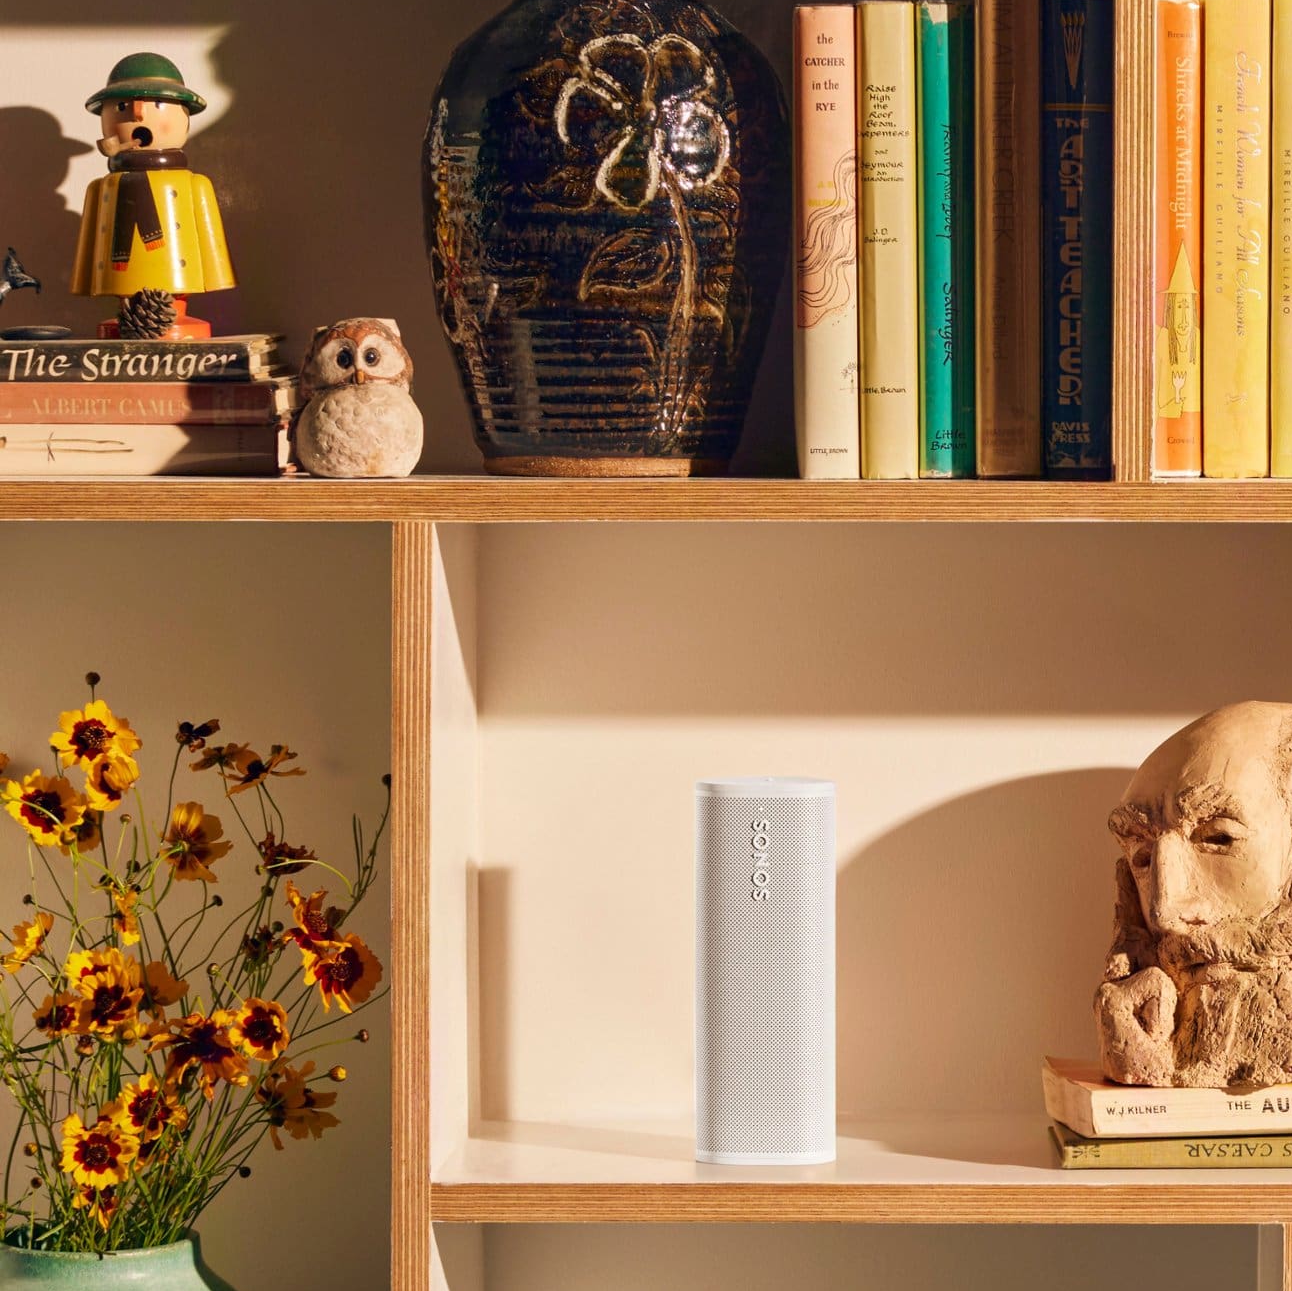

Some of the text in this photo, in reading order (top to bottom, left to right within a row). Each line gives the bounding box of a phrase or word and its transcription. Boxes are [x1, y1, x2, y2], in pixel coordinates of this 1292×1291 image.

[816, 34, 833, 45] the
[805, 57, 845, 67] CATCHER
[812, 80, 840, 91] in the
[816, 102, 836, 112] RYE
[1169, 57, 1193, 230] Shrieks at Midnight
[1057, 215, 1083, 406] TEACHER
[2, 349, 237, 381] The Stranger
[31, 397, 112, 416] ALBERT
[119, 396, 192, 416] CAMUS
[750, 819, 770, 902] SONOS
[1227, 1100, 1252, 1111] THE
[1184, 1141, 1272, 1158] CAESAR
